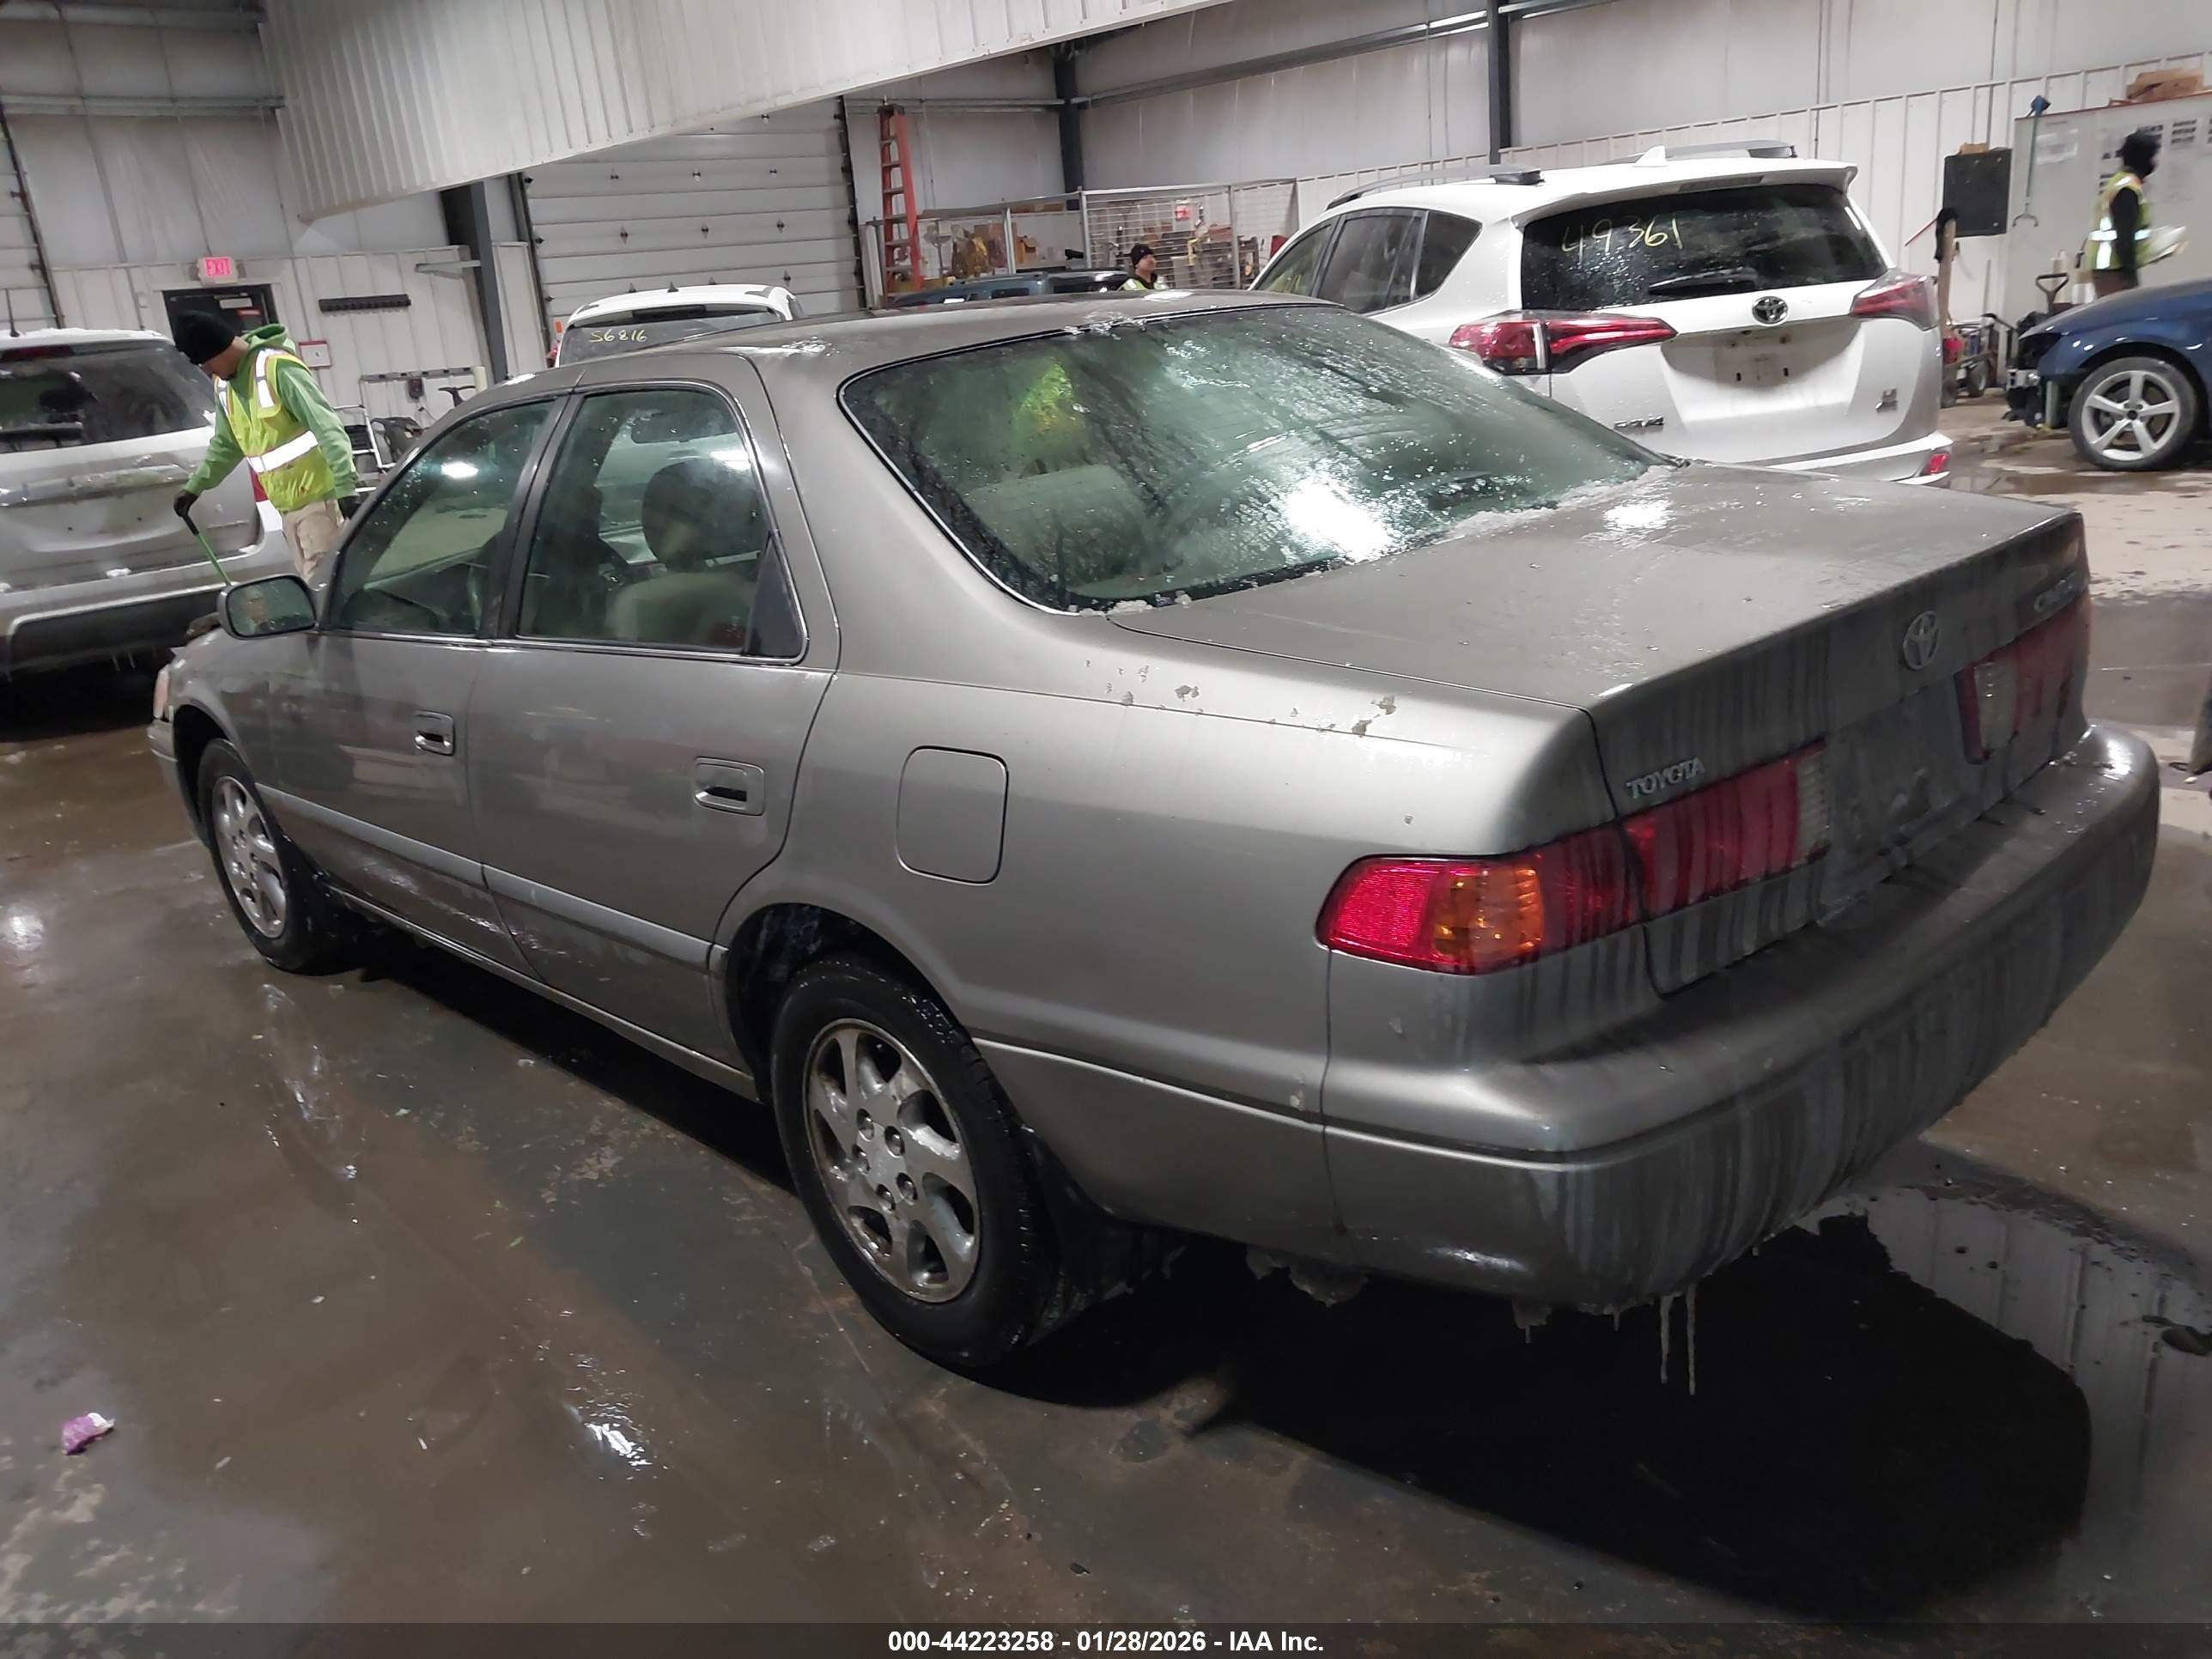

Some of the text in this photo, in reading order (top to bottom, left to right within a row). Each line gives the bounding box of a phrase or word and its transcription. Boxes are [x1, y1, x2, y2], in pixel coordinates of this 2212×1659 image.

[1561, 216, 1683, 264] 49361
[206, 258, 230, 276] EXIT
[1626, 757, 1705, 799] TOYOTA
